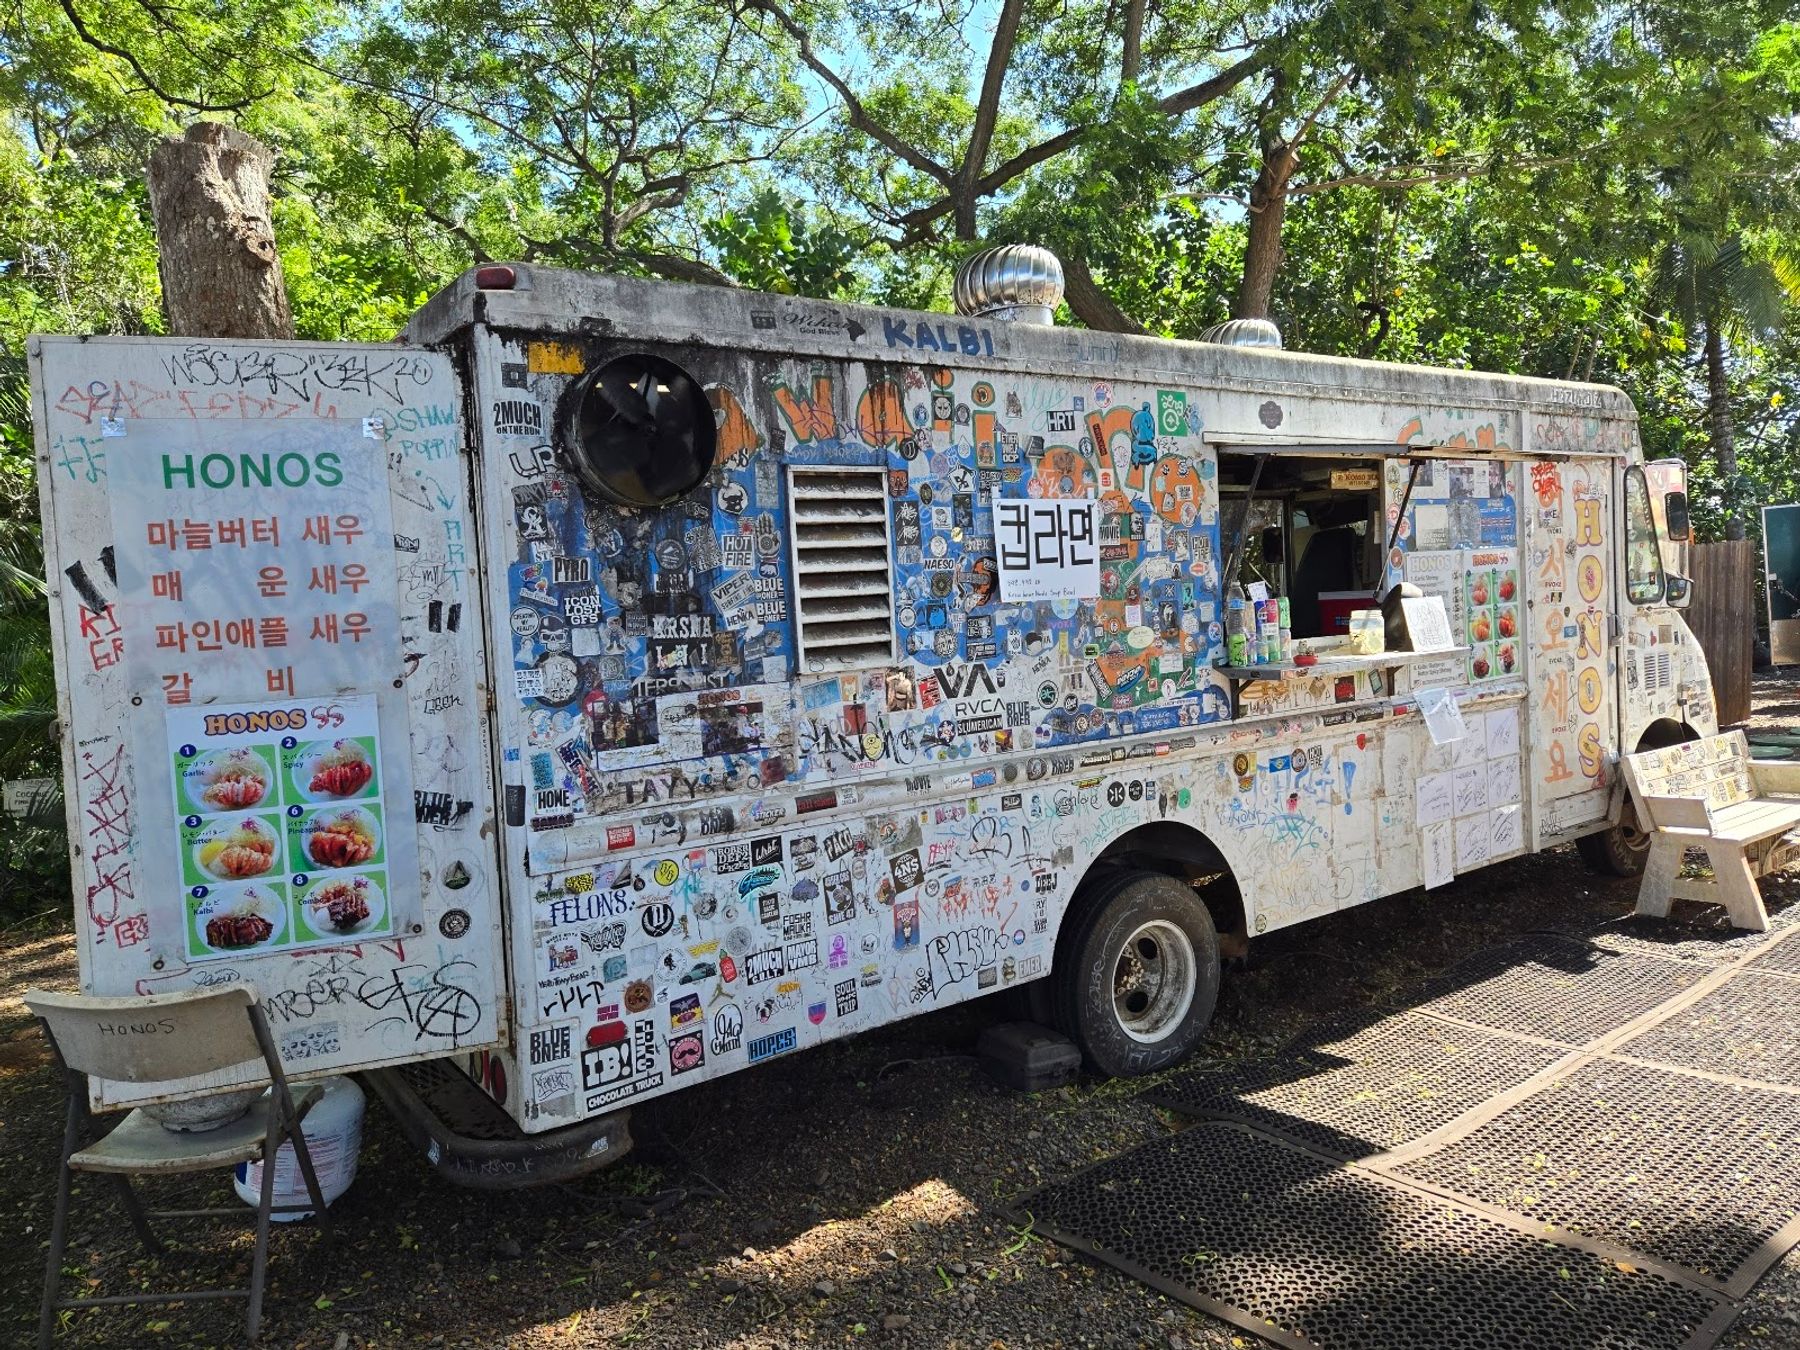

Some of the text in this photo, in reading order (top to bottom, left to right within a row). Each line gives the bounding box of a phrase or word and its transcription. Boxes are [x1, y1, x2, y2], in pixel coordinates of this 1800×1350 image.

[883, 316, 994, 356] KALBI
[493, 401, 542, 427] 2MUCH
[1048, 411, 1075, 431] HRT
[162, 452, 344, 489] HONOS
[148, 514, 364, 551] 마늘버터 새우
[726, 535, 751, 550] HOT
[1000, 504, 1094, 570] 컵라면
[726, 552, 751, 566] FIRE
[924, 558, 954, 570] NAESO
[152, 563, 370, 602] 매 운 새우
[713, 573, 750, 600] VIPER
[755, 578, 784, 592] BLUE
[564, 595, 600, 607] ICON
[565, 604, 601, 616] LOST
[757, 601, 786, 615] BLUE
[570, 614, 598, 625] GFS
[156, 613, 371, 653] 파인애플 새우
[1574, 499, 1604, 779] HONOS
[161, 668, 294, 704] 갈 비
[1007, 701, 1029, 716] BLUE
[204, 708, 306, 736] HONOS
[958, 715, 1002, 735] SLUMERICAN
[182, 761, 304, 778] Garlic Spicy
[187, 825, 325, 846] Butter Pineapple
[193, 906, 214, 915] Kalbi
[747, 950, 783, 978] 2MUCH
[838, 999, 857, 1016] TRIP
[98, 1019, 176, 1037] HONOS
[530, 1027, 571, 1049] BLUE
[749, 1030, 795, 1058] HOPES
[530, 1047, 571, 1064] ONER
[585, 1041, 631, 1087] IB!
[588, 1075, 662, 1110] CHOCOLATE TRUCK
